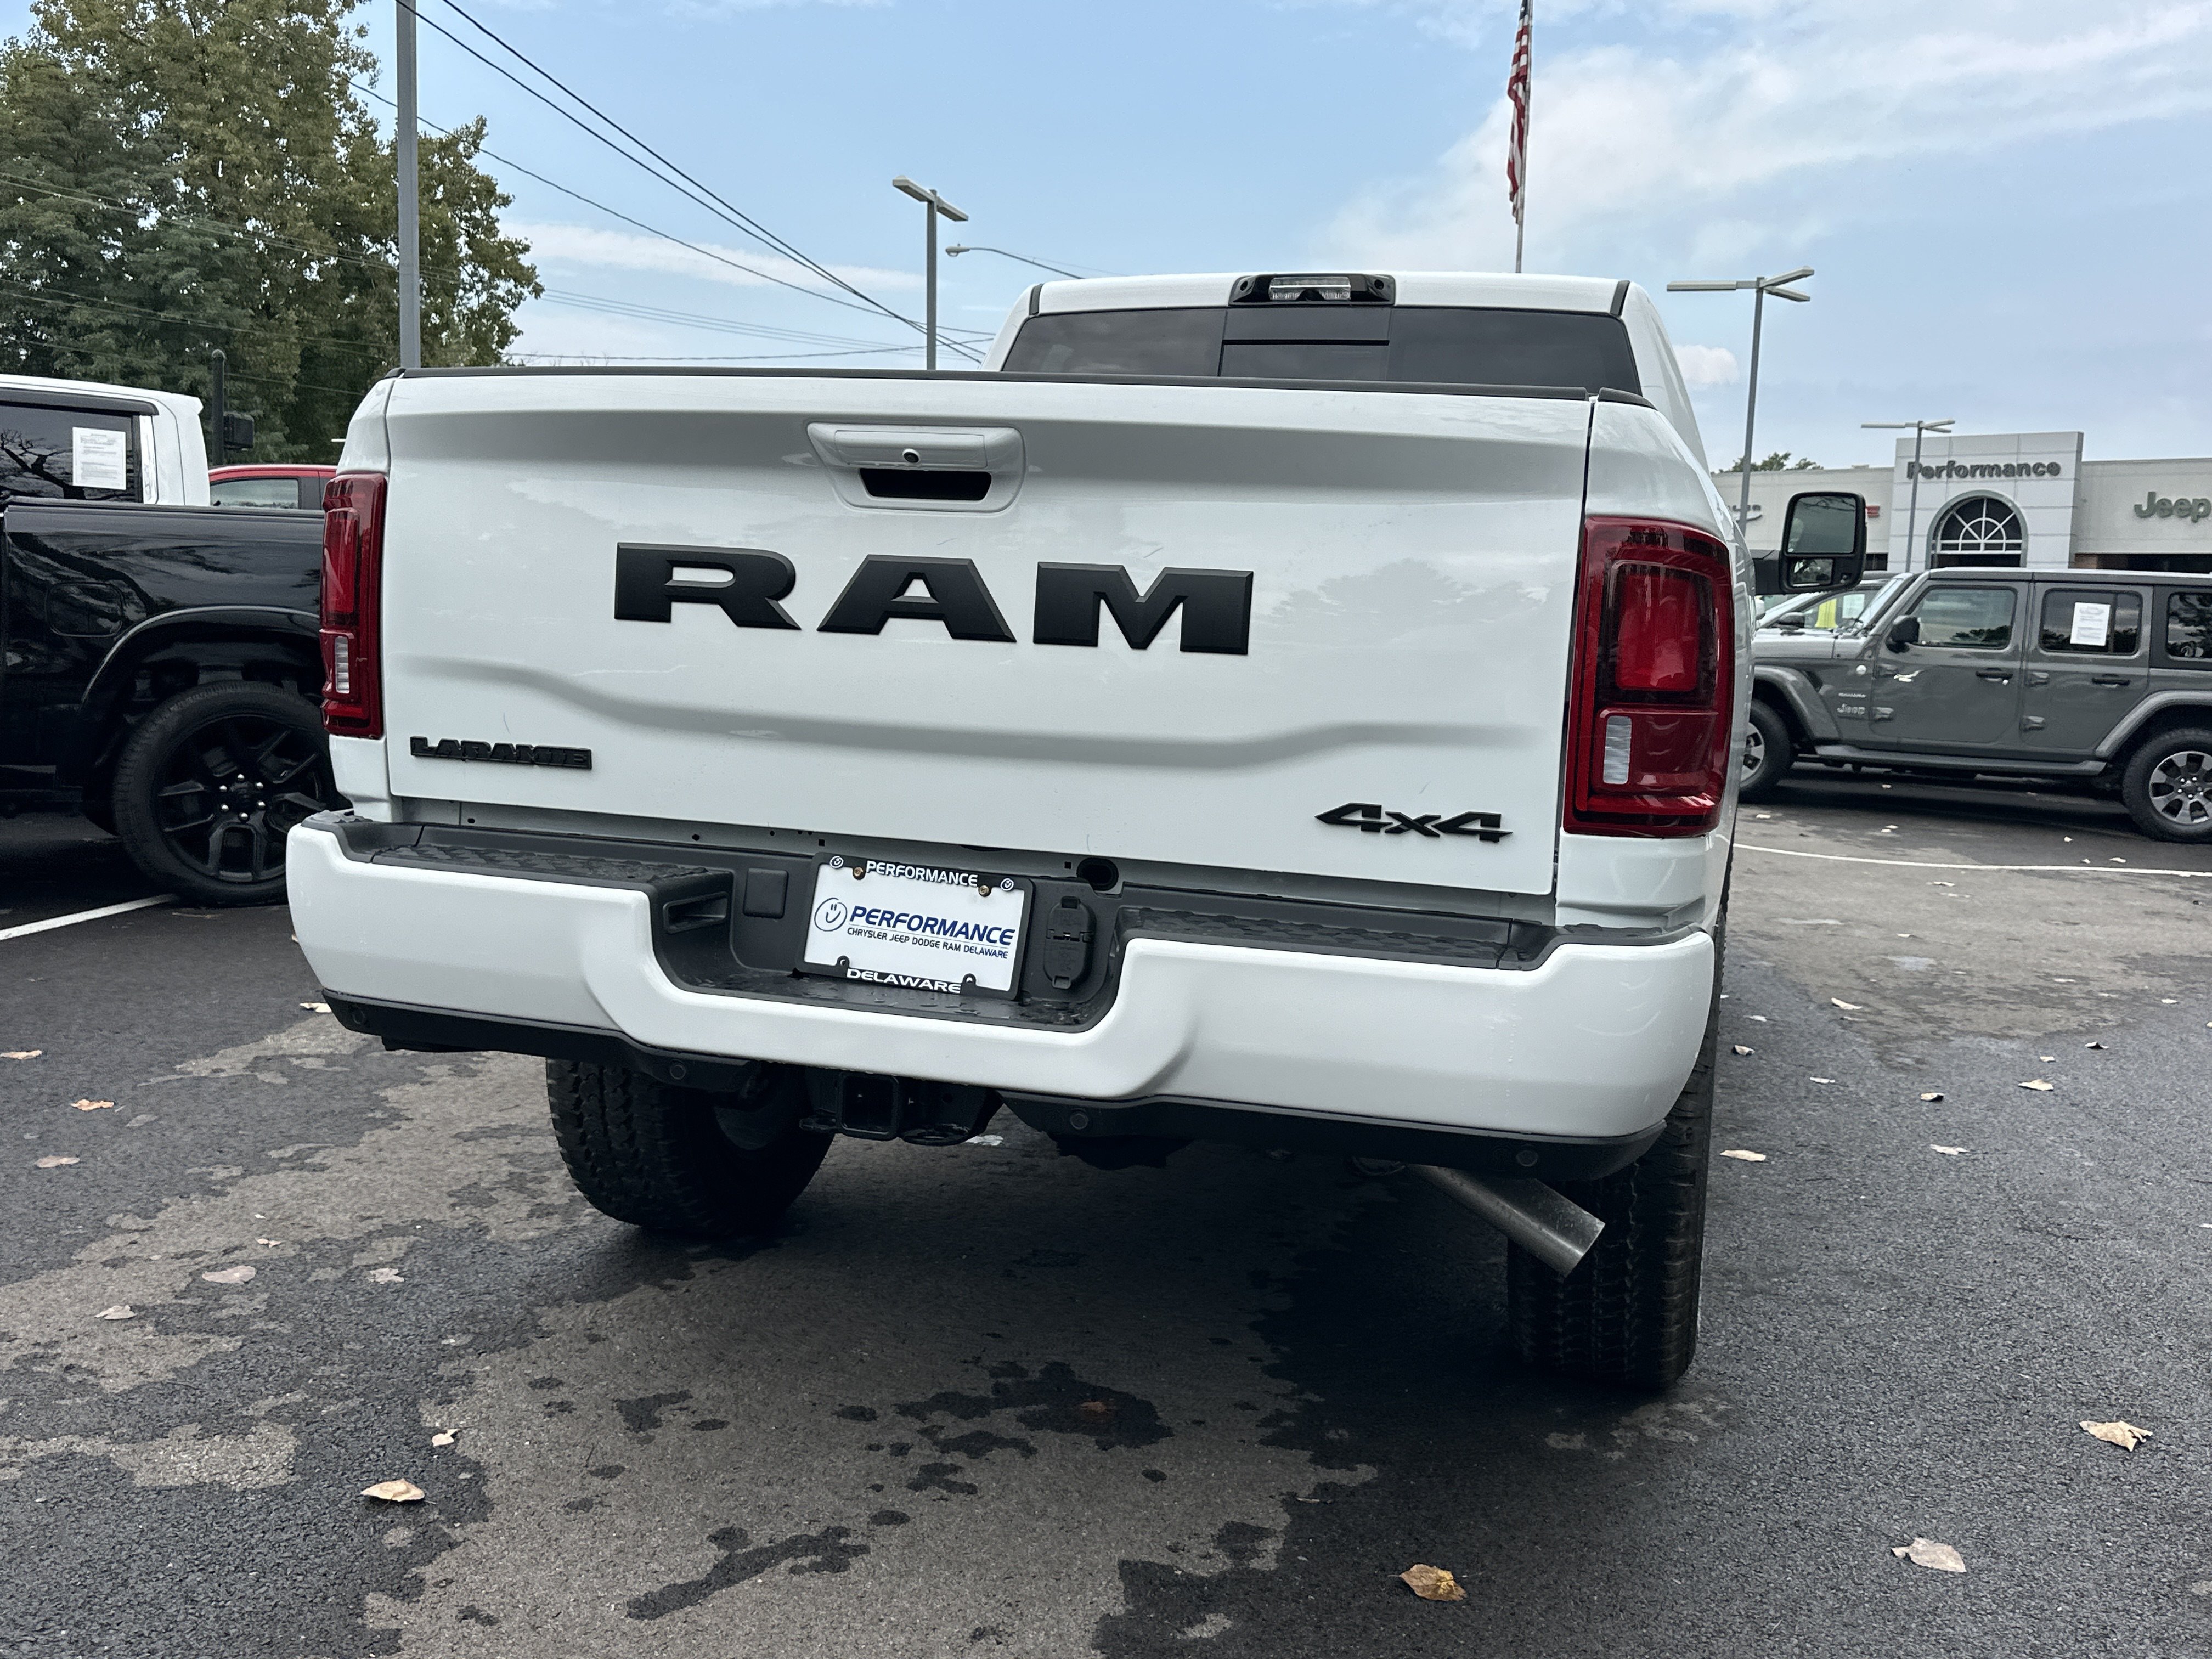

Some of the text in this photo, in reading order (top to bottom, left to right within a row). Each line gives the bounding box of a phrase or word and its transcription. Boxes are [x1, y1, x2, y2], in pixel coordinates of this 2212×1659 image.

[1906, 460, 2061, 479] Performance
[2134, 492, 2211, 523] Jeep
[614, 542, 1254, 656] RAM
[1837, 703, 1865, 715] Jeep
[410, 736, 592, 769] LARAMIE
[866, 860, 978, 887] PERFORMANCE
[849, 905, 1015, 946] PERFORMANCE
[847, 927, 1008, 959] CHRYSLER JEEP DODGE RAM DELAWARE
[846, 968, 962, 994] DELAWARE
